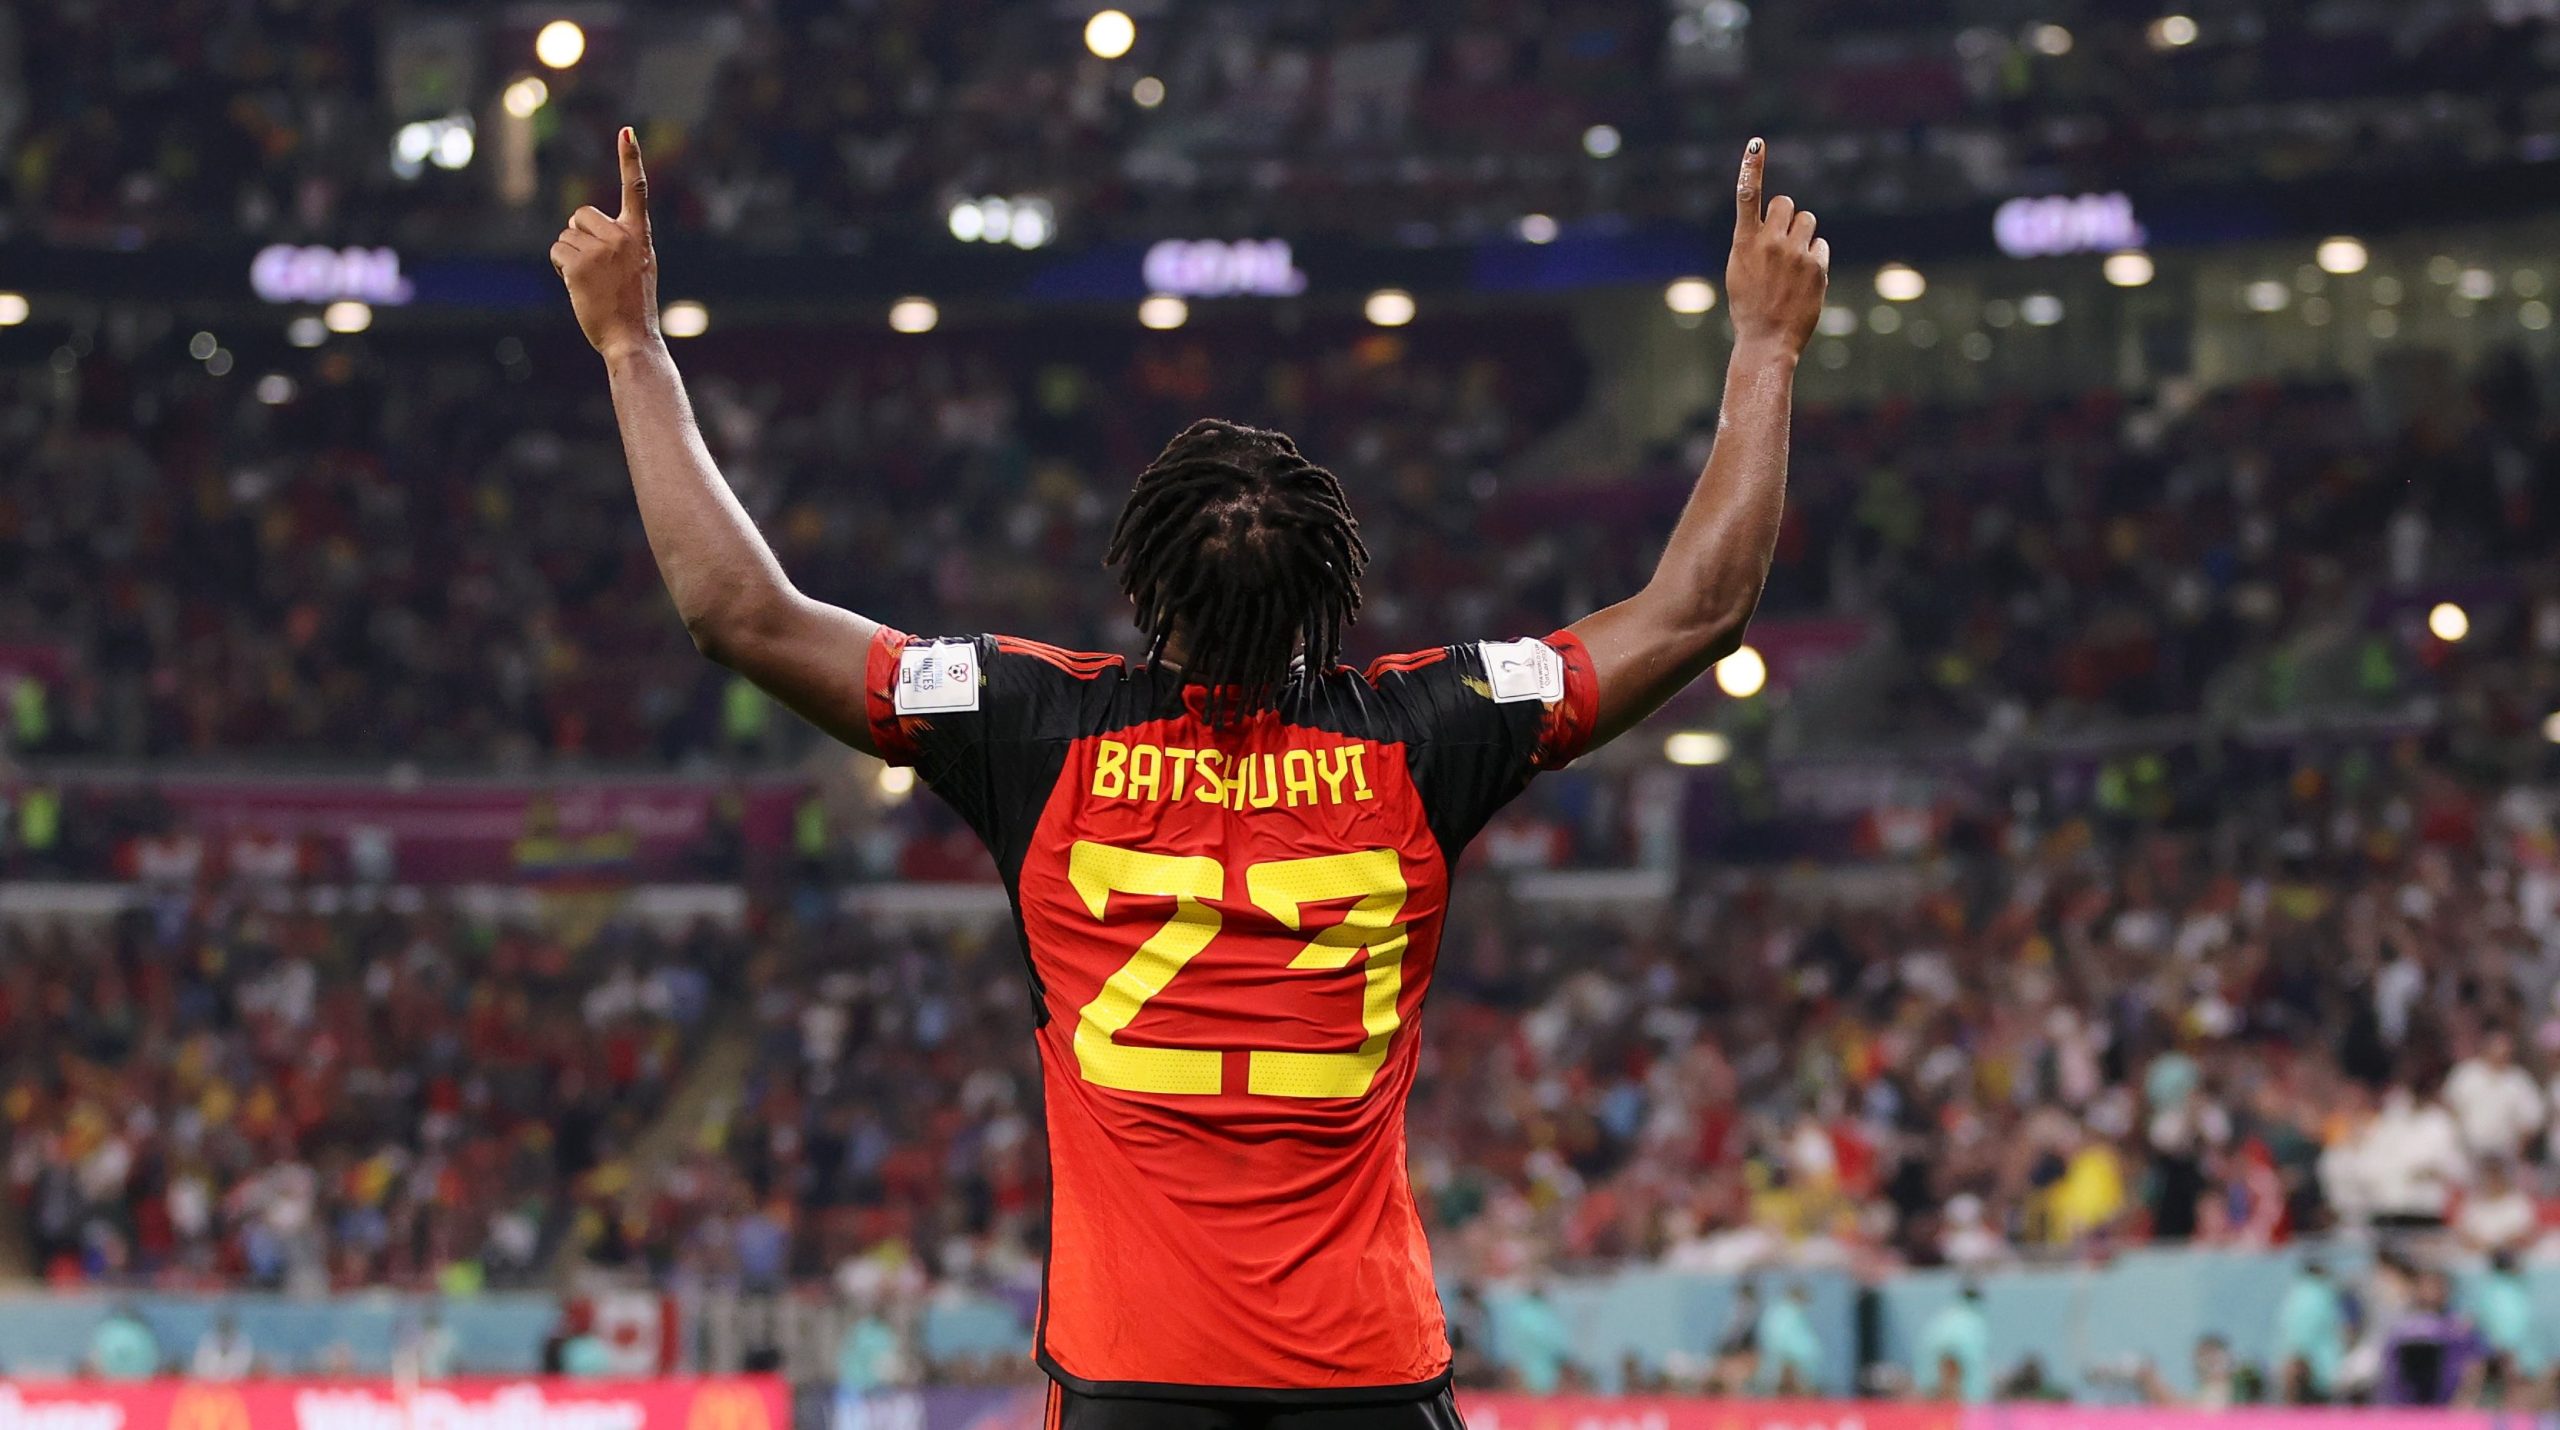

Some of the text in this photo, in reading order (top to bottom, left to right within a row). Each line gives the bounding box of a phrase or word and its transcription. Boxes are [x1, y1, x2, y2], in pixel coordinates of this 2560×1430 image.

[922, 657, 934, 690] UNITES
[1091, 740, 1374, 811] BATSHUAYI
[1068, 839, 1408, 1099] 23
